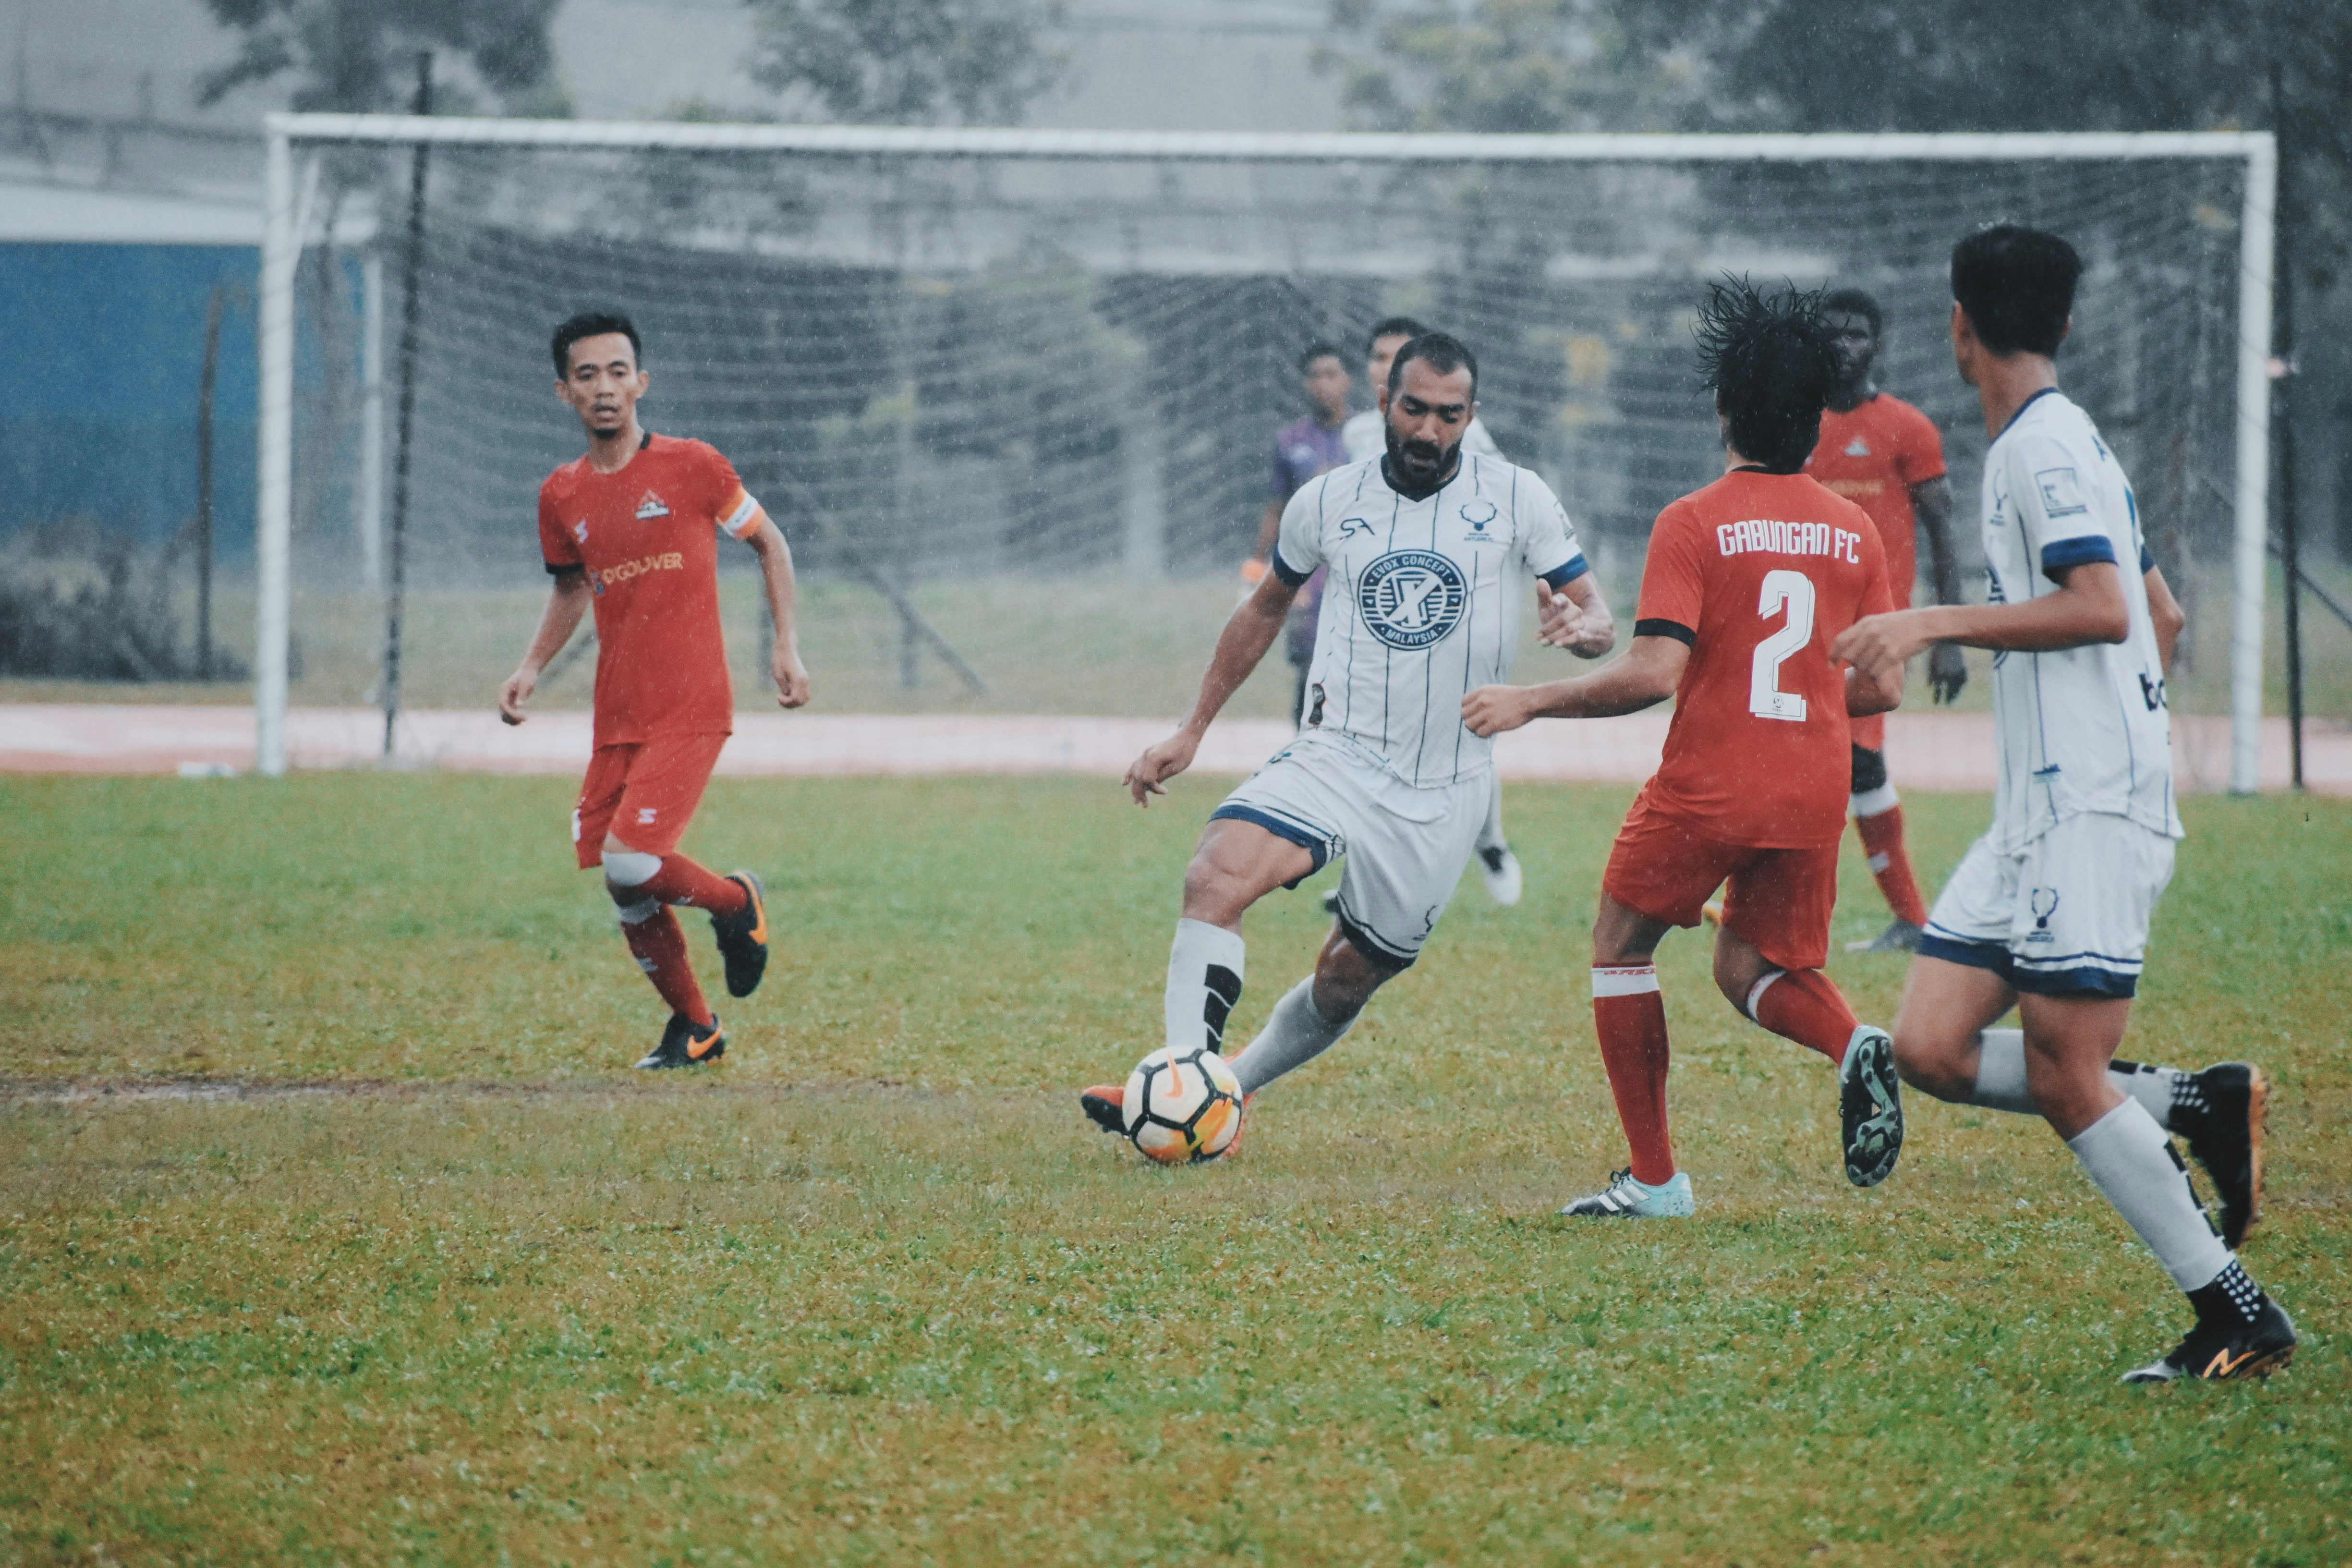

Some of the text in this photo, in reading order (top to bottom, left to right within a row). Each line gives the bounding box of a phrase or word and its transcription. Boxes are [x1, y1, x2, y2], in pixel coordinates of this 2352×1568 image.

[1717, 520, 1860, 563] GABUNGAN FC
[1371, 555, 1451, 579] EVOX CONCEPT
[1385, 629, 1439, 644] MALAYSIA
[1749, 570, 1815, 721] 2
